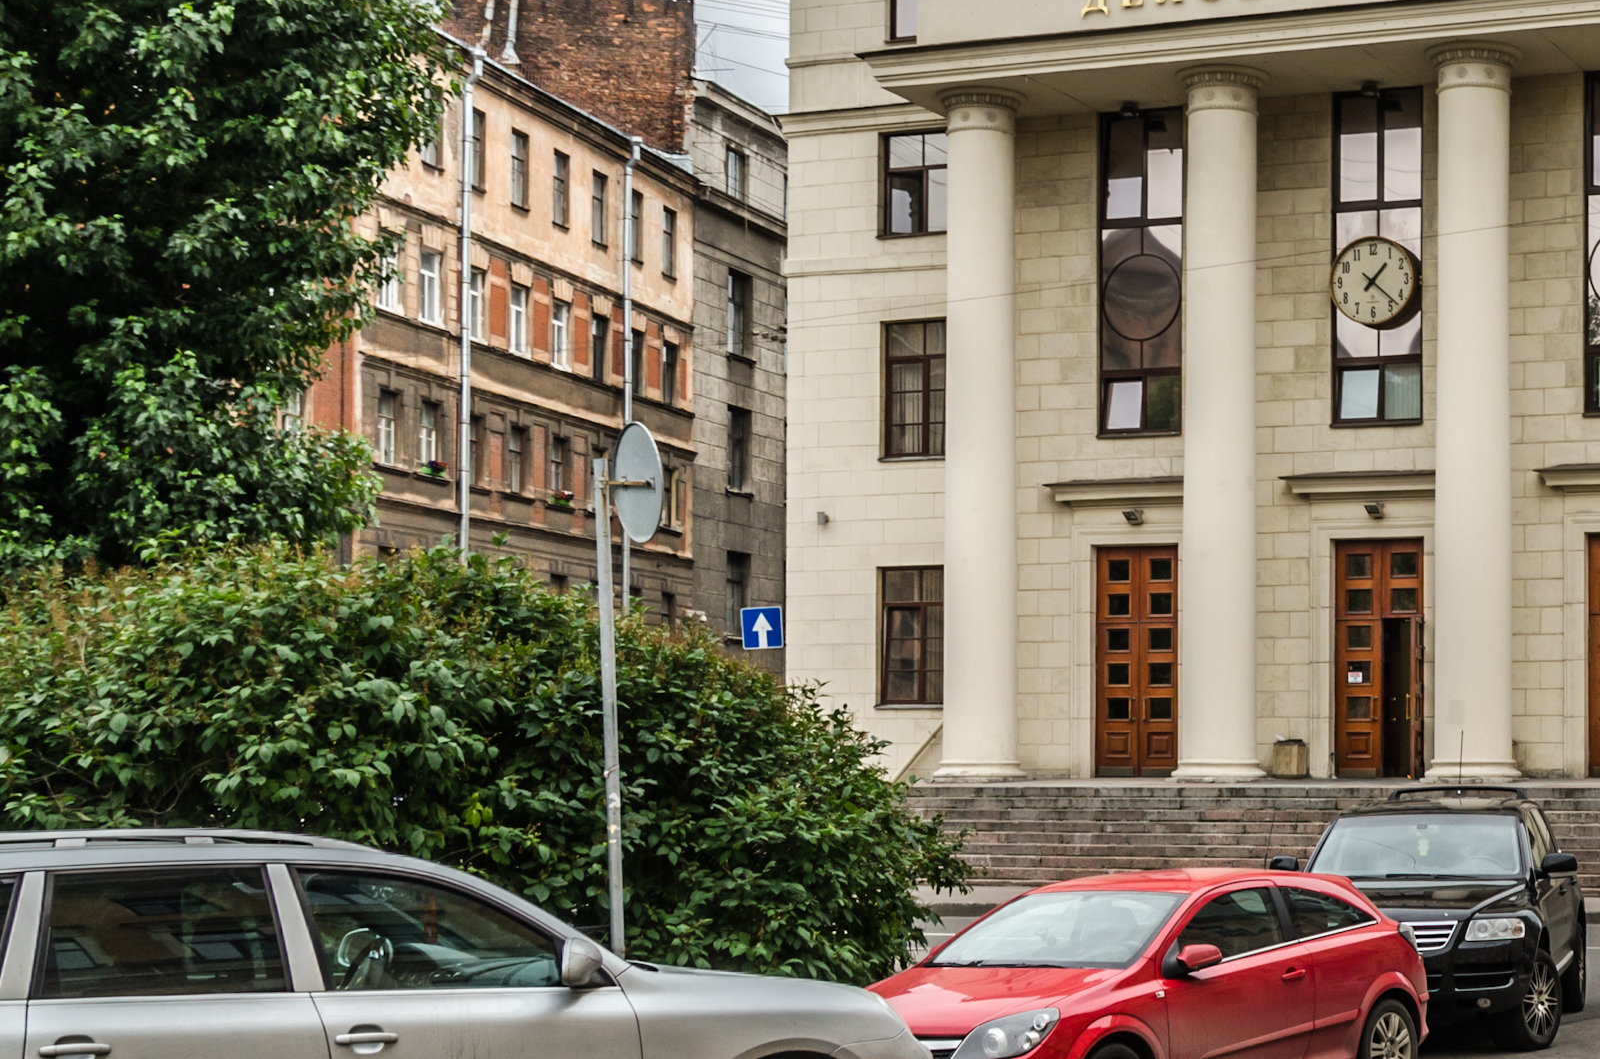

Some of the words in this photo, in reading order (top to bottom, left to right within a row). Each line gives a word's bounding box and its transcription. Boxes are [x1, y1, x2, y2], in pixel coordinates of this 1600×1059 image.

[1353, 249, 1361, 261] 11
[1369, 243, 1378, 256] 12
[1388, 247, 1392, 260] 1
[1342, 261, 1350, 274] 10
[1398, 257, 1404, 270] 2
[1337, 276, 1343, 289] 9
[1403, 272, 1409, 285] 3
[1343, 292, 1348, 305] 8
[1398, 288, 1404, 301] 4
[1354, 302, 1360, 315] 7
[1370, 306, 1376, 319] 6
[1388, 300, 1393, 313] 5
